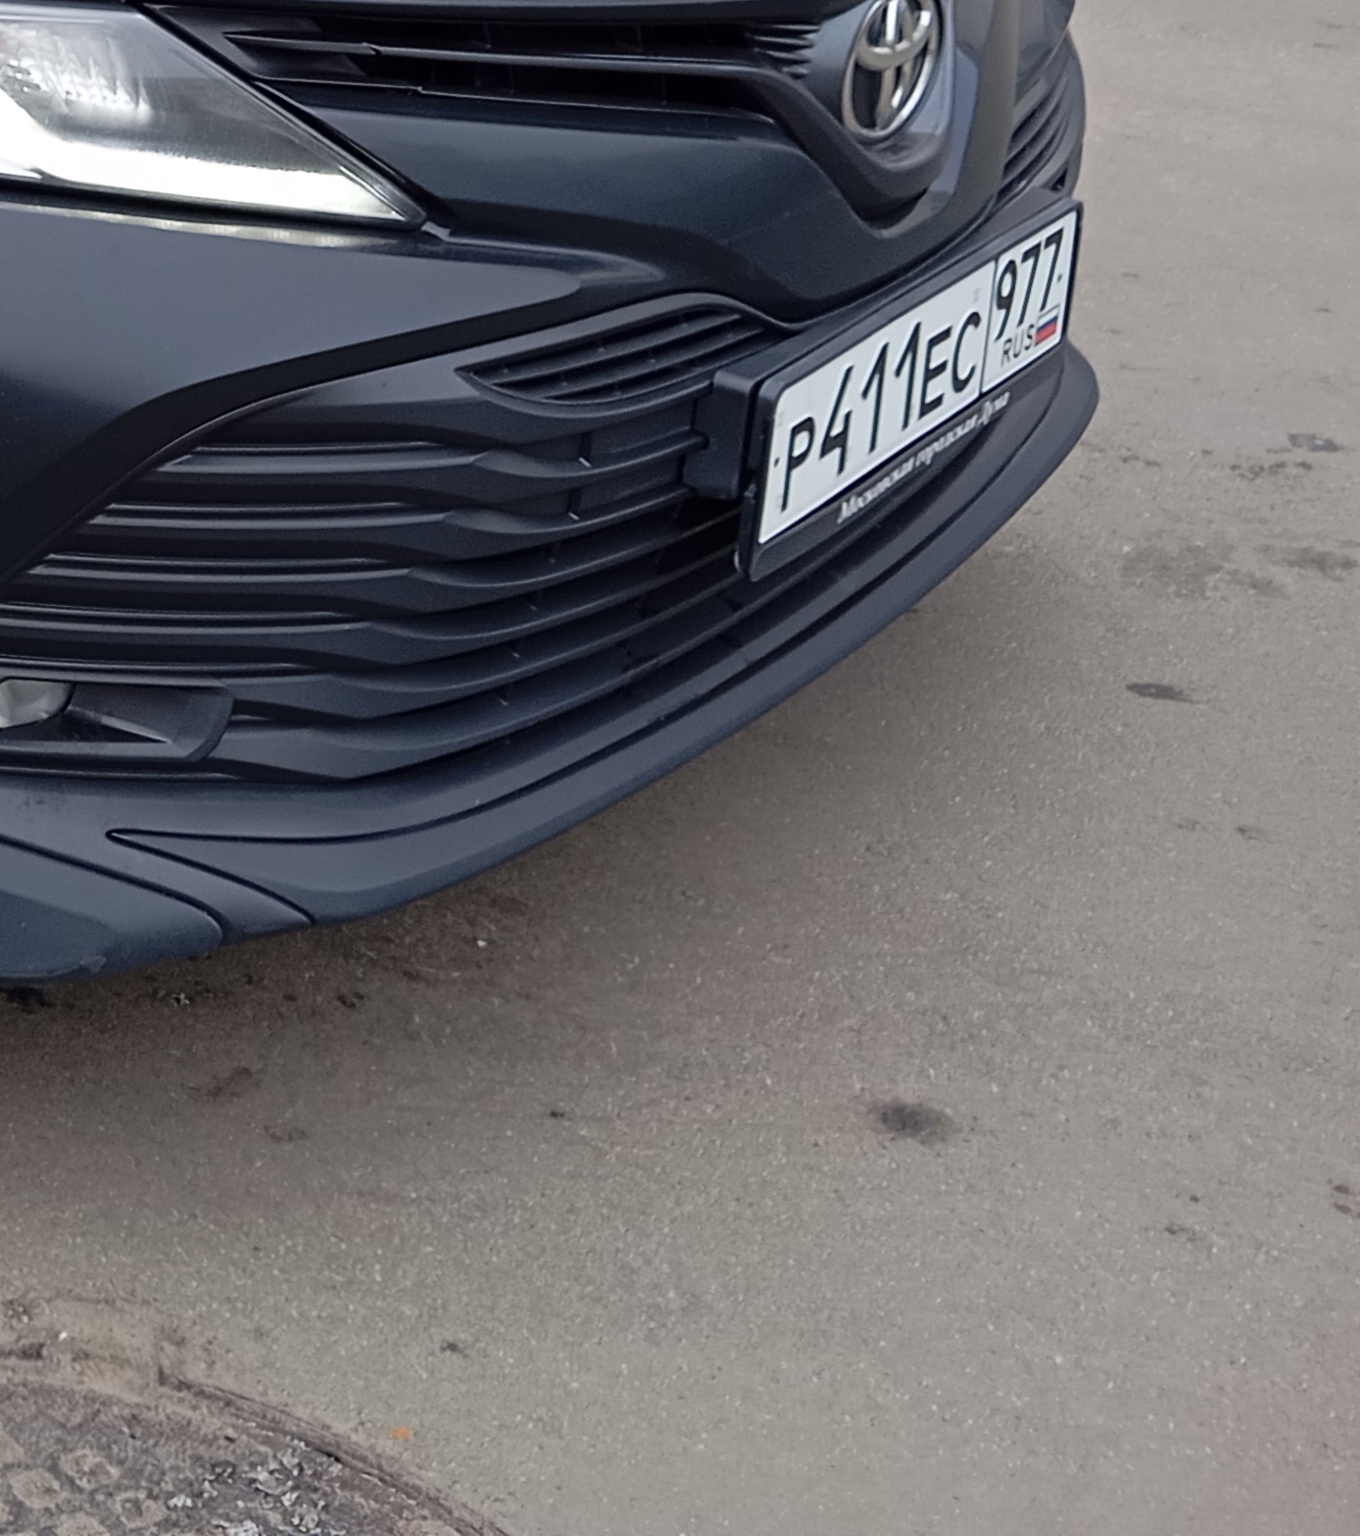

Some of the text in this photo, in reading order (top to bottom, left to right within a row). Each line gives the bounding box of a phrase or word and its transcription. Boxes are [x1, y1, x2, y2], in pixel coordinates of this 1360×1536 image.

[780, 227, 1065, 514] Р411ЕС 977
[1001, 323, 1036, 368] RUS
